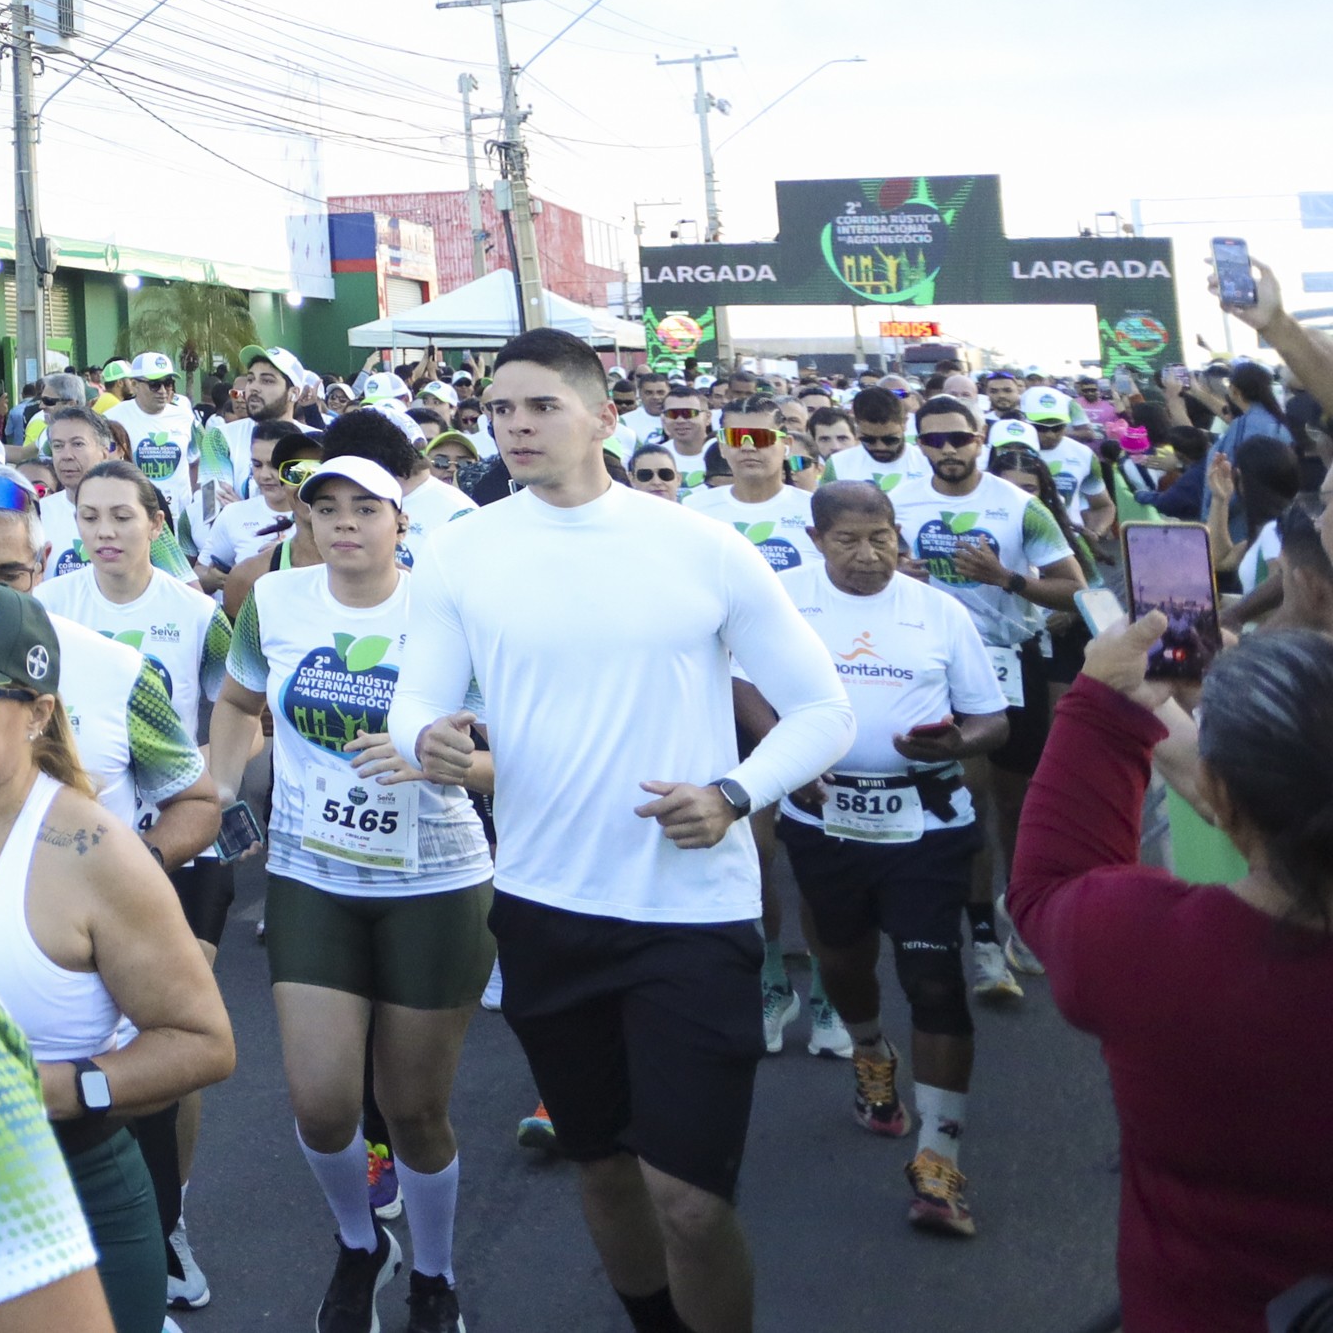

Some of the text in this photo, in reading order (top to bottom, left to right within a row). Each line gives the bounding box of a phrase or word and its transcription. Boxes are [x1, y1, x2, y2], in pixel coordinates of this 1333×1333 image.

[836, 212, 941, 225] CORRIDA RÚSTICA
[837, 224, 932, 234] INTERNACIONAL
[846, 233, 933, 244] AGRONEGÓCIO
[642, 265, 777, 283] LARGADA
[1012, 260, 1171, 279] LARGADA
[150, 626, 180, 637] Seiva
[300, 667, 353, 683] CORRIDA
[297, 676, 395, 699] INTERNACIONA
[302, 687, 390, 710] AGRONEGÓCI
[836, 792, 902, 815] 5810
[322, 798, 399, 834] 5165
